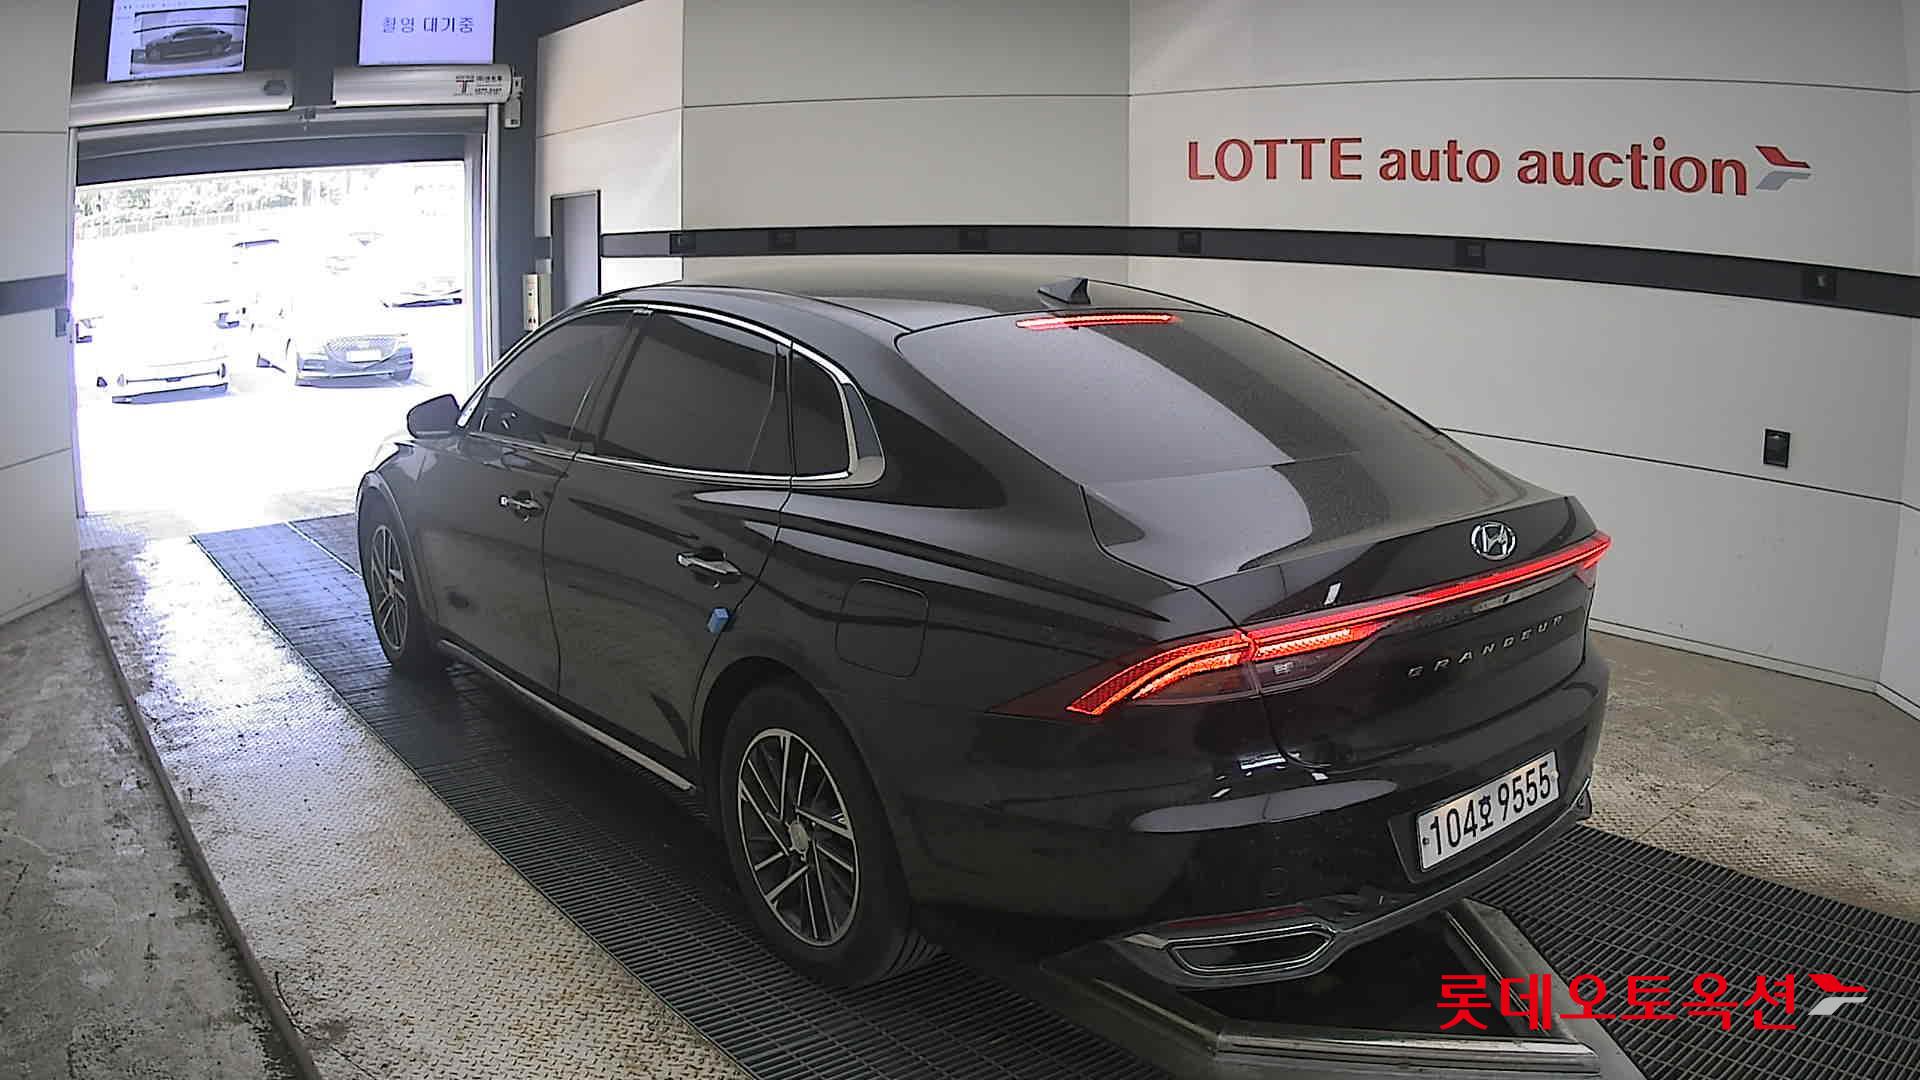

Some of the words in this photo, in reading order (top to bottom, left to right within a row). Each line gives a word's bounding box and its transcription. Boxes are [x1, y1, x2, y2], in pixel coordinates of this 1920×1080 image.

[423, 16, 473, 33] 대기중
[1187, 137, 1362, 182] LOTTE
[1379, 140, 1501, 184] auto
[1517, 136, 1748, 196] auction
[1407, 614, 1565, 679] GRANDEUR
[1429, 794, 1494, 855] 104호
[1498, 761, 1552, 821] 9555
